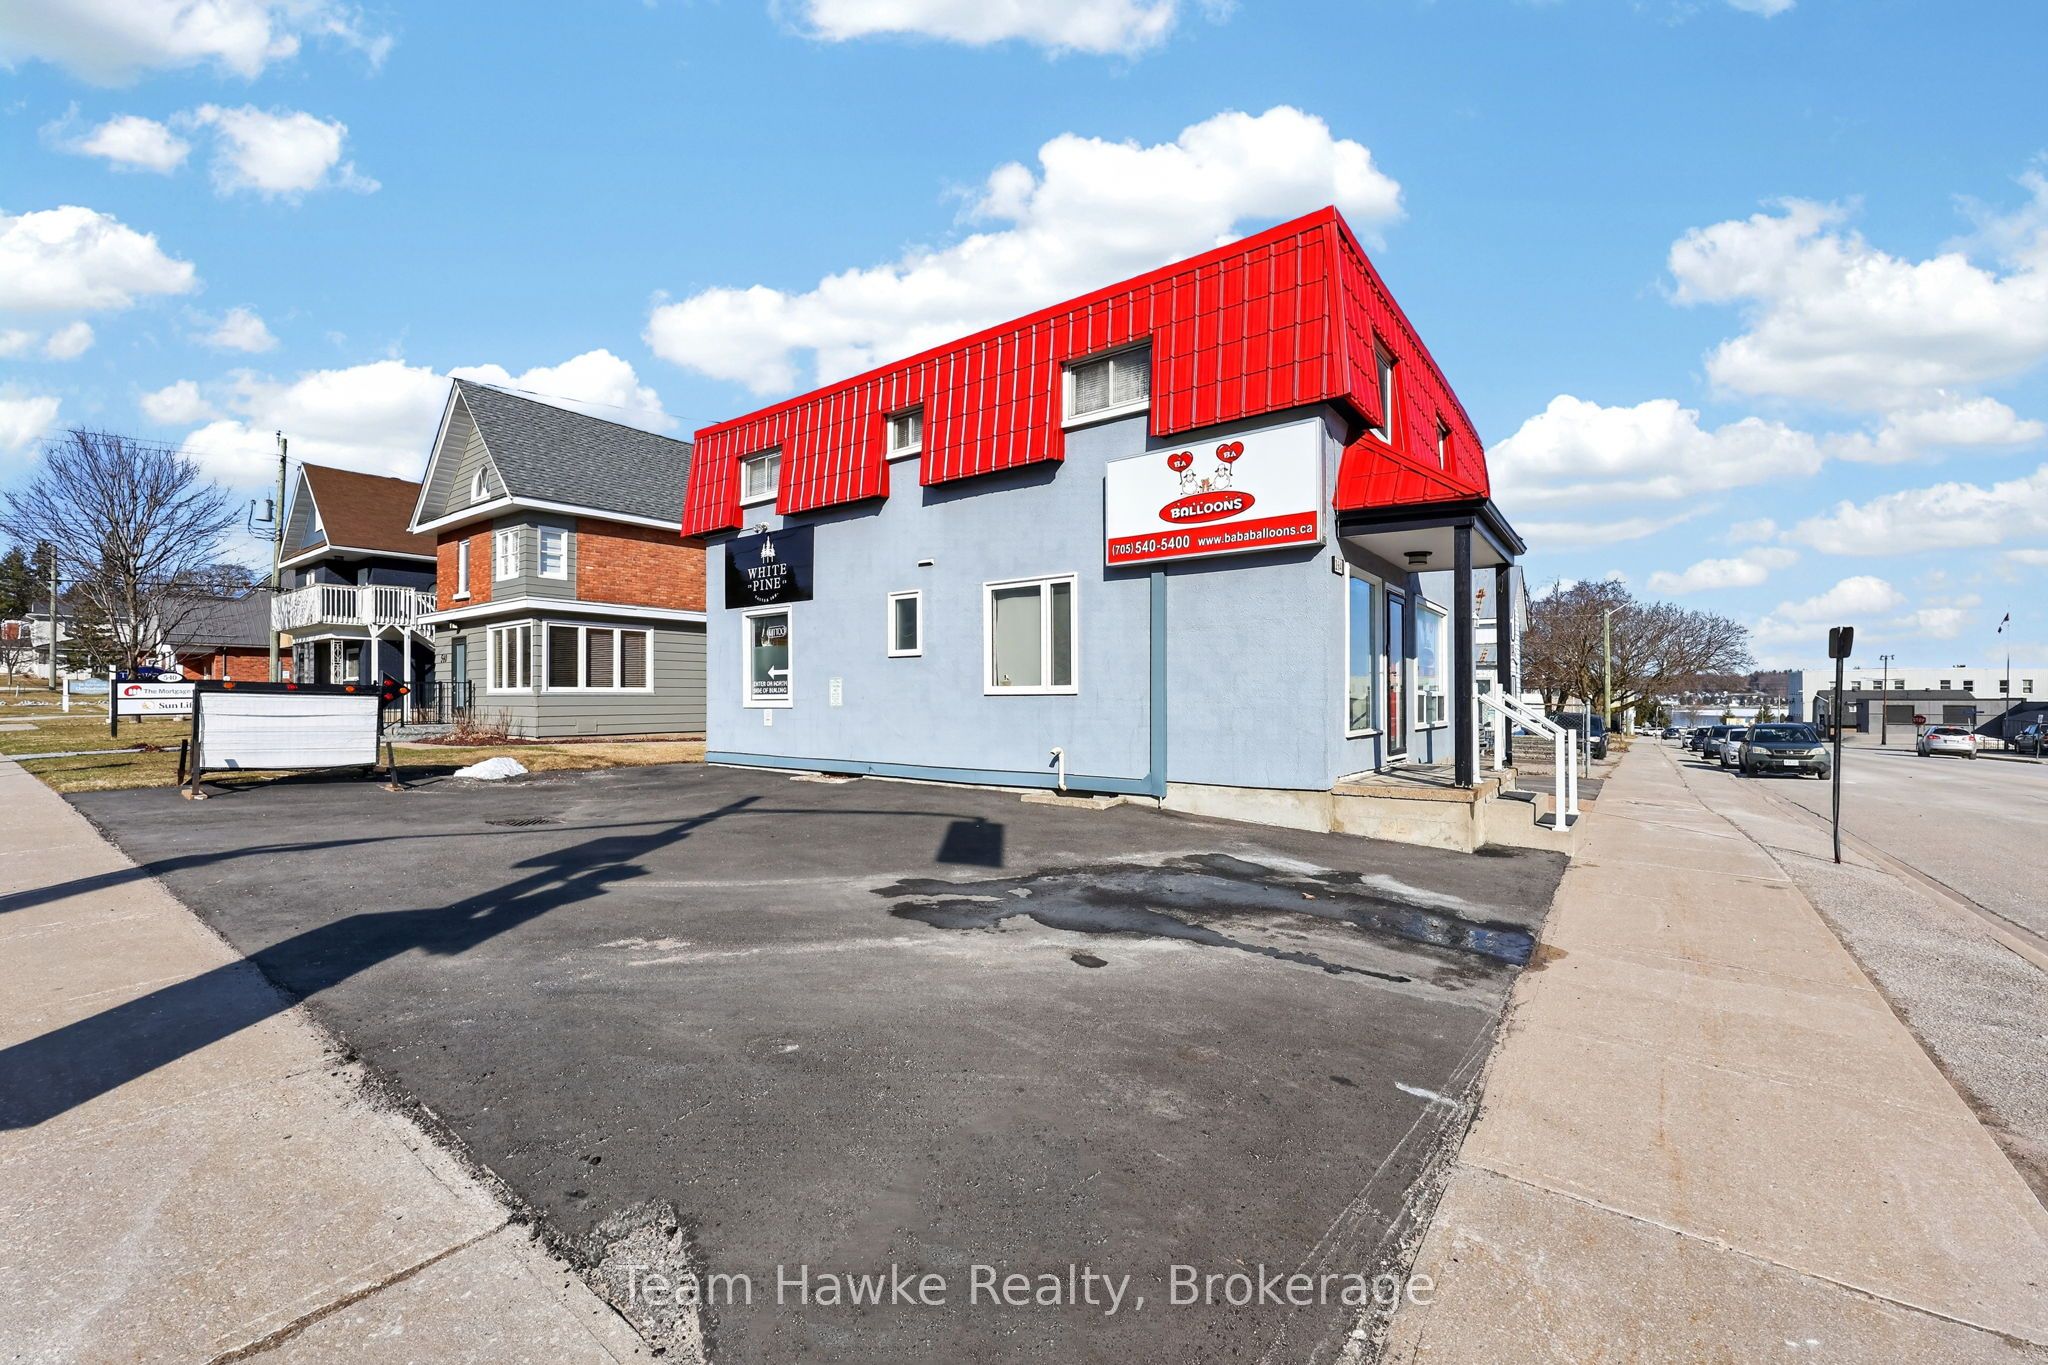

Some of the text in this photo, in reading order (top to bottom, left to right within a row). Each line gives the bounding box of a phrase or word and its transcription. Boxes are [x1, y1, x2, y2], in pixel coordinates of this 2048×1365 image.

[1223, 450, 1237, 459] BA
[1173, 460, 1187, 468] BA
[1170, 498, 1243, 519] BALLOONS
[1112, 524, 1313, 556] (705) 540-5400 www.bababalloons.ca
[747, 563, 787, 580] WHITE
[753, 577, 780, 592] PINE
